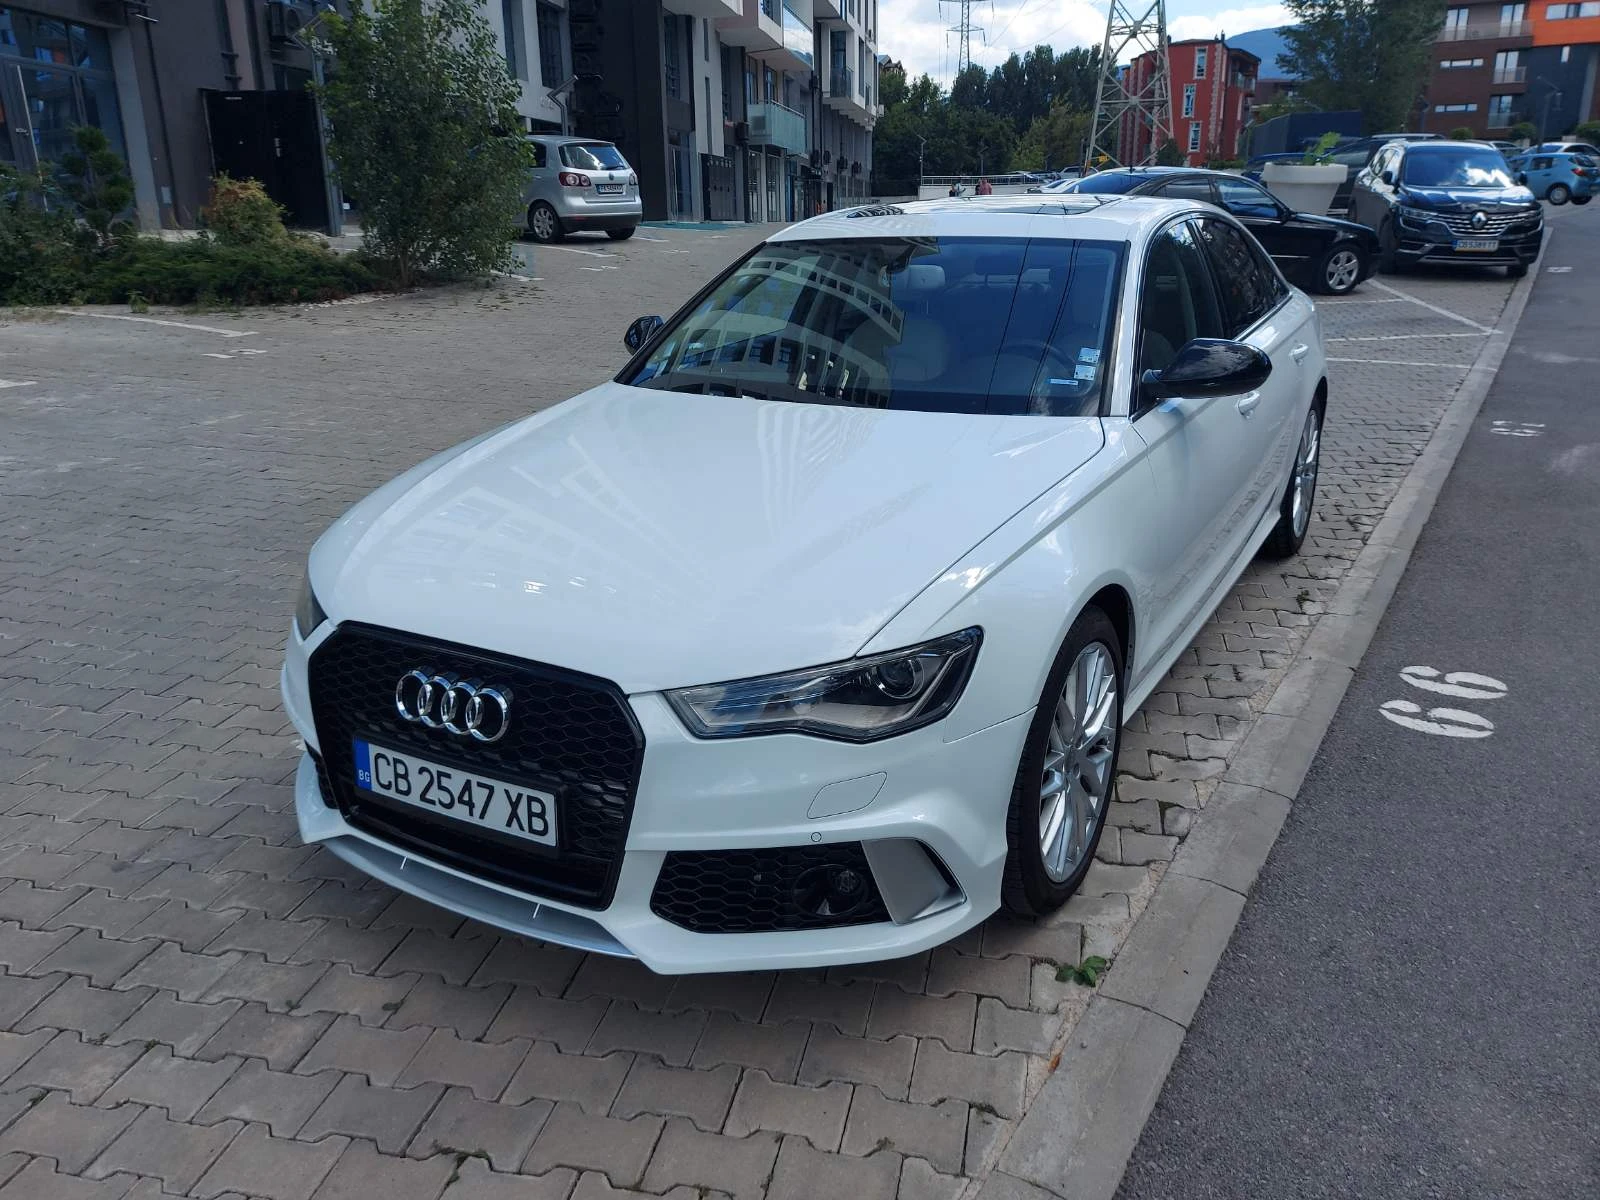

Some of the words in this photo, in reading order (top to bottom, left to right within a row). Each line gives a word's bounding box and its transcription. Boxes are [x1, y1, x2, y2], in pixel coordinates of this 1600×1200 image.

[1378, 665, 1508, 738] 66
[358, 769, 371, 783] BG
[374, 752, 412, 797] CB
[418, 766, 494, 820] 2547
[503, 788, 549, 837] XB
